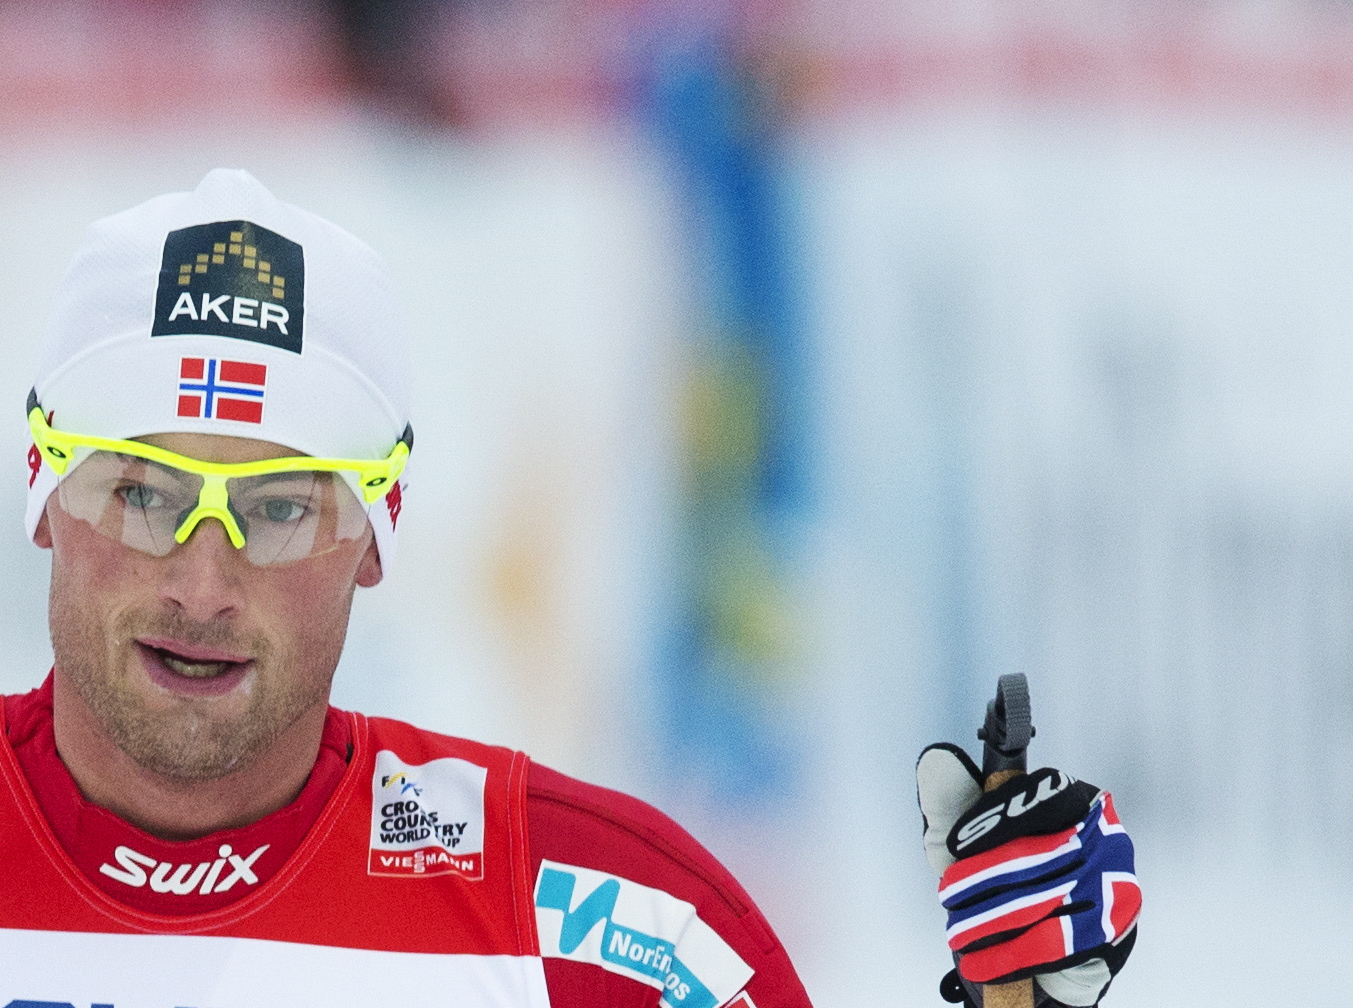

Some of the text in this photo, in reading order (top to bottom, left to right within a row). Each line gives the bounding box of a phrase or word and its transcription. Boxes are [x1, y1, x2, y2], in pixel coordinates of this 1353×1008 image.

[168, 291, 290, 336] AKER
[380, 800, 439, 824] CROS
[379, 827, 431, 844] WORLD
